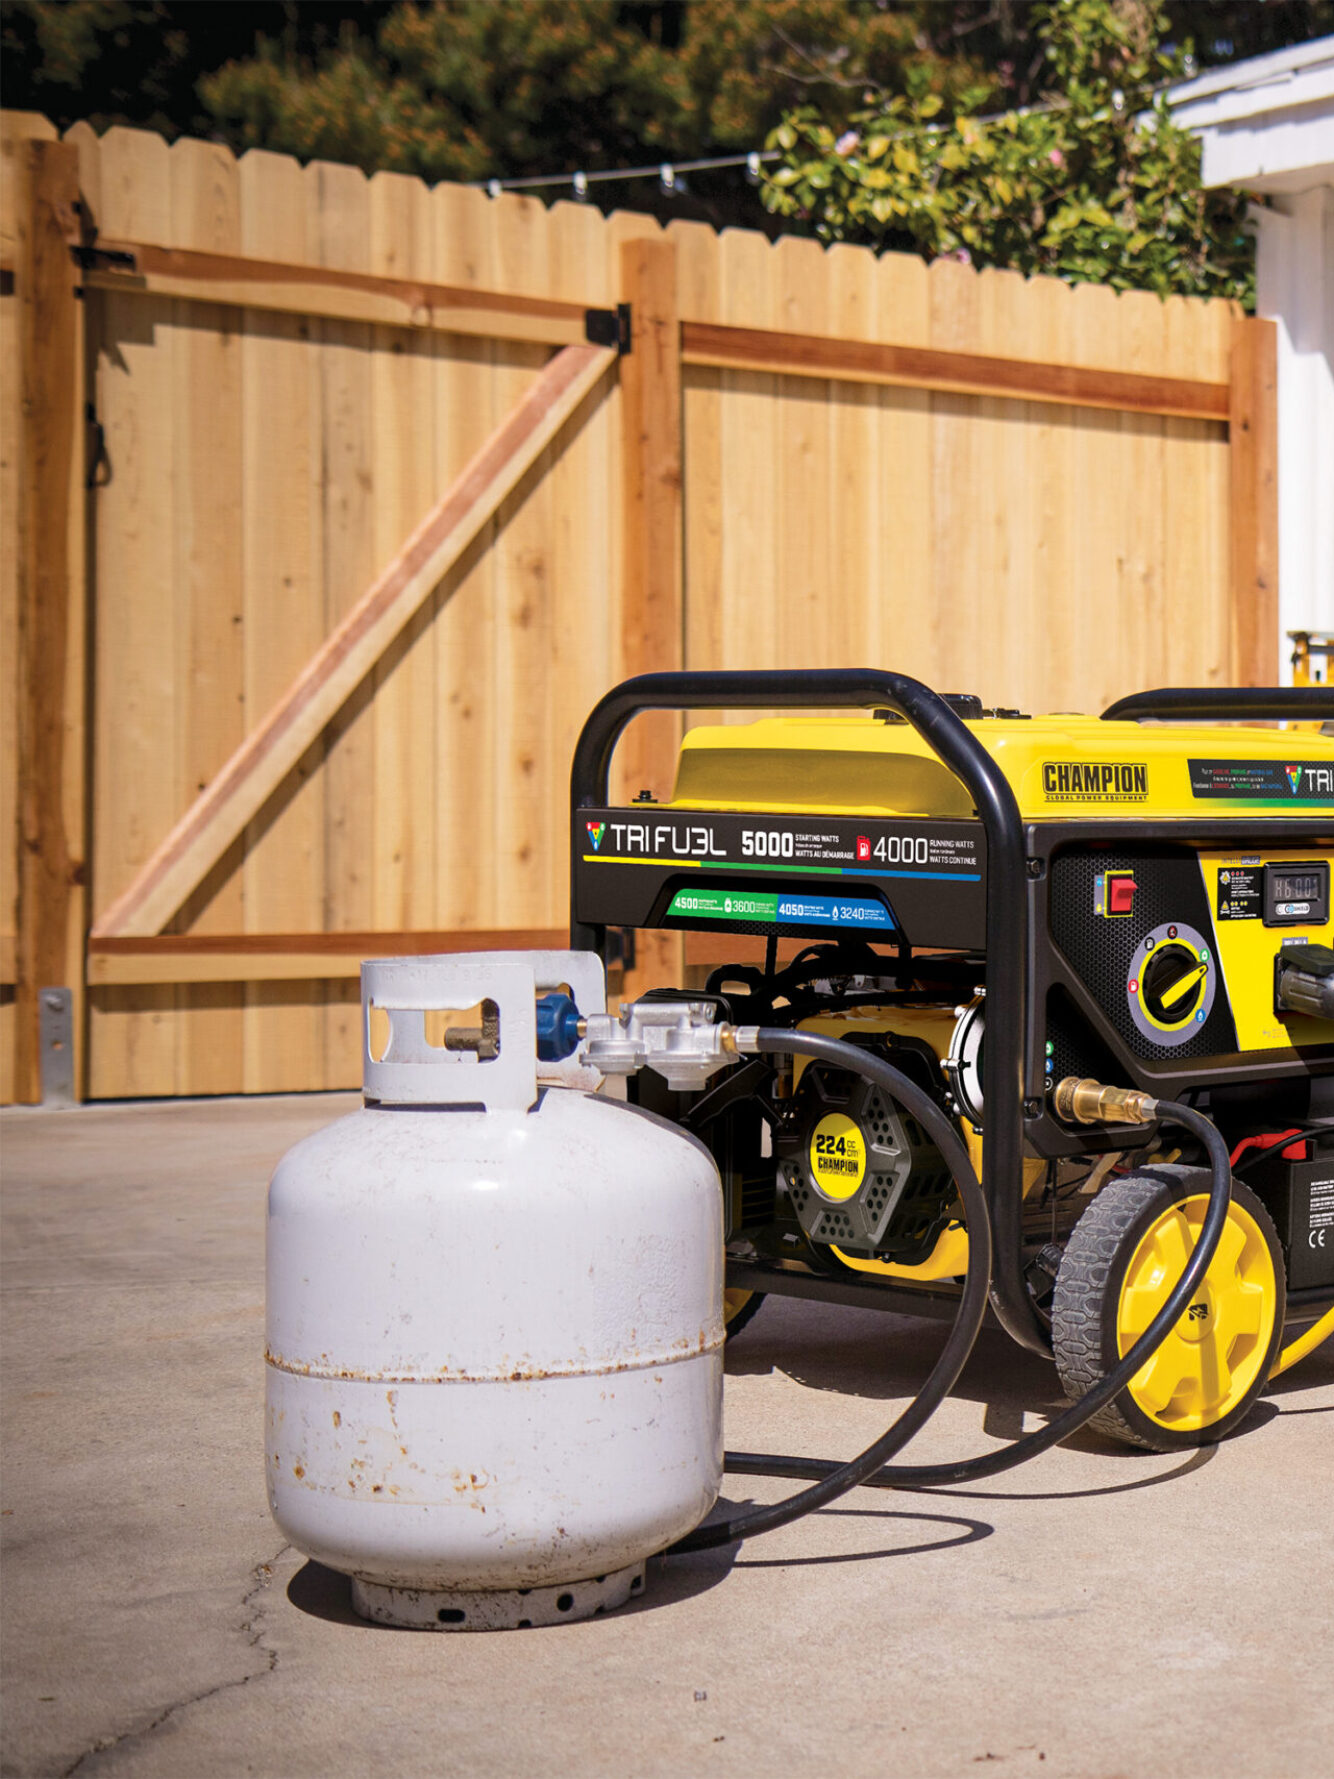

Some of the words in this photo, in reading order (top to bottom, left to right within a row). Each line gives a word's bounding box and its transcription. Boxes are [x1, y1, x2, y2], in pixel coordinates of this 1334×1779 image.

[1043, 764, 1147, 793] CHAMPION
[741, 830, 794, 858] 5000
[795, 833, 820, 842] STARTING
[821, 834, 840, 843] WATTS
[929, 839, 955, 848] RUNNING
[955, 840, 975, 849] WATTS
[795, 849, 813, 858] WATTS
[873, 836, 928, 864] 4000
[929, 855, 948, 864] WATTS
[674, 896, 698, 910] 4500
[732, 900, 756, 913] 3600
[778, 903, 804, 916] 4050
[840, 906, 865, 920] 3240
[816, 1134, 846, 1156] 224
[818, 1156, 859, 1173] CHAMPION
[1308, 1229, 1326, 1249] CE
